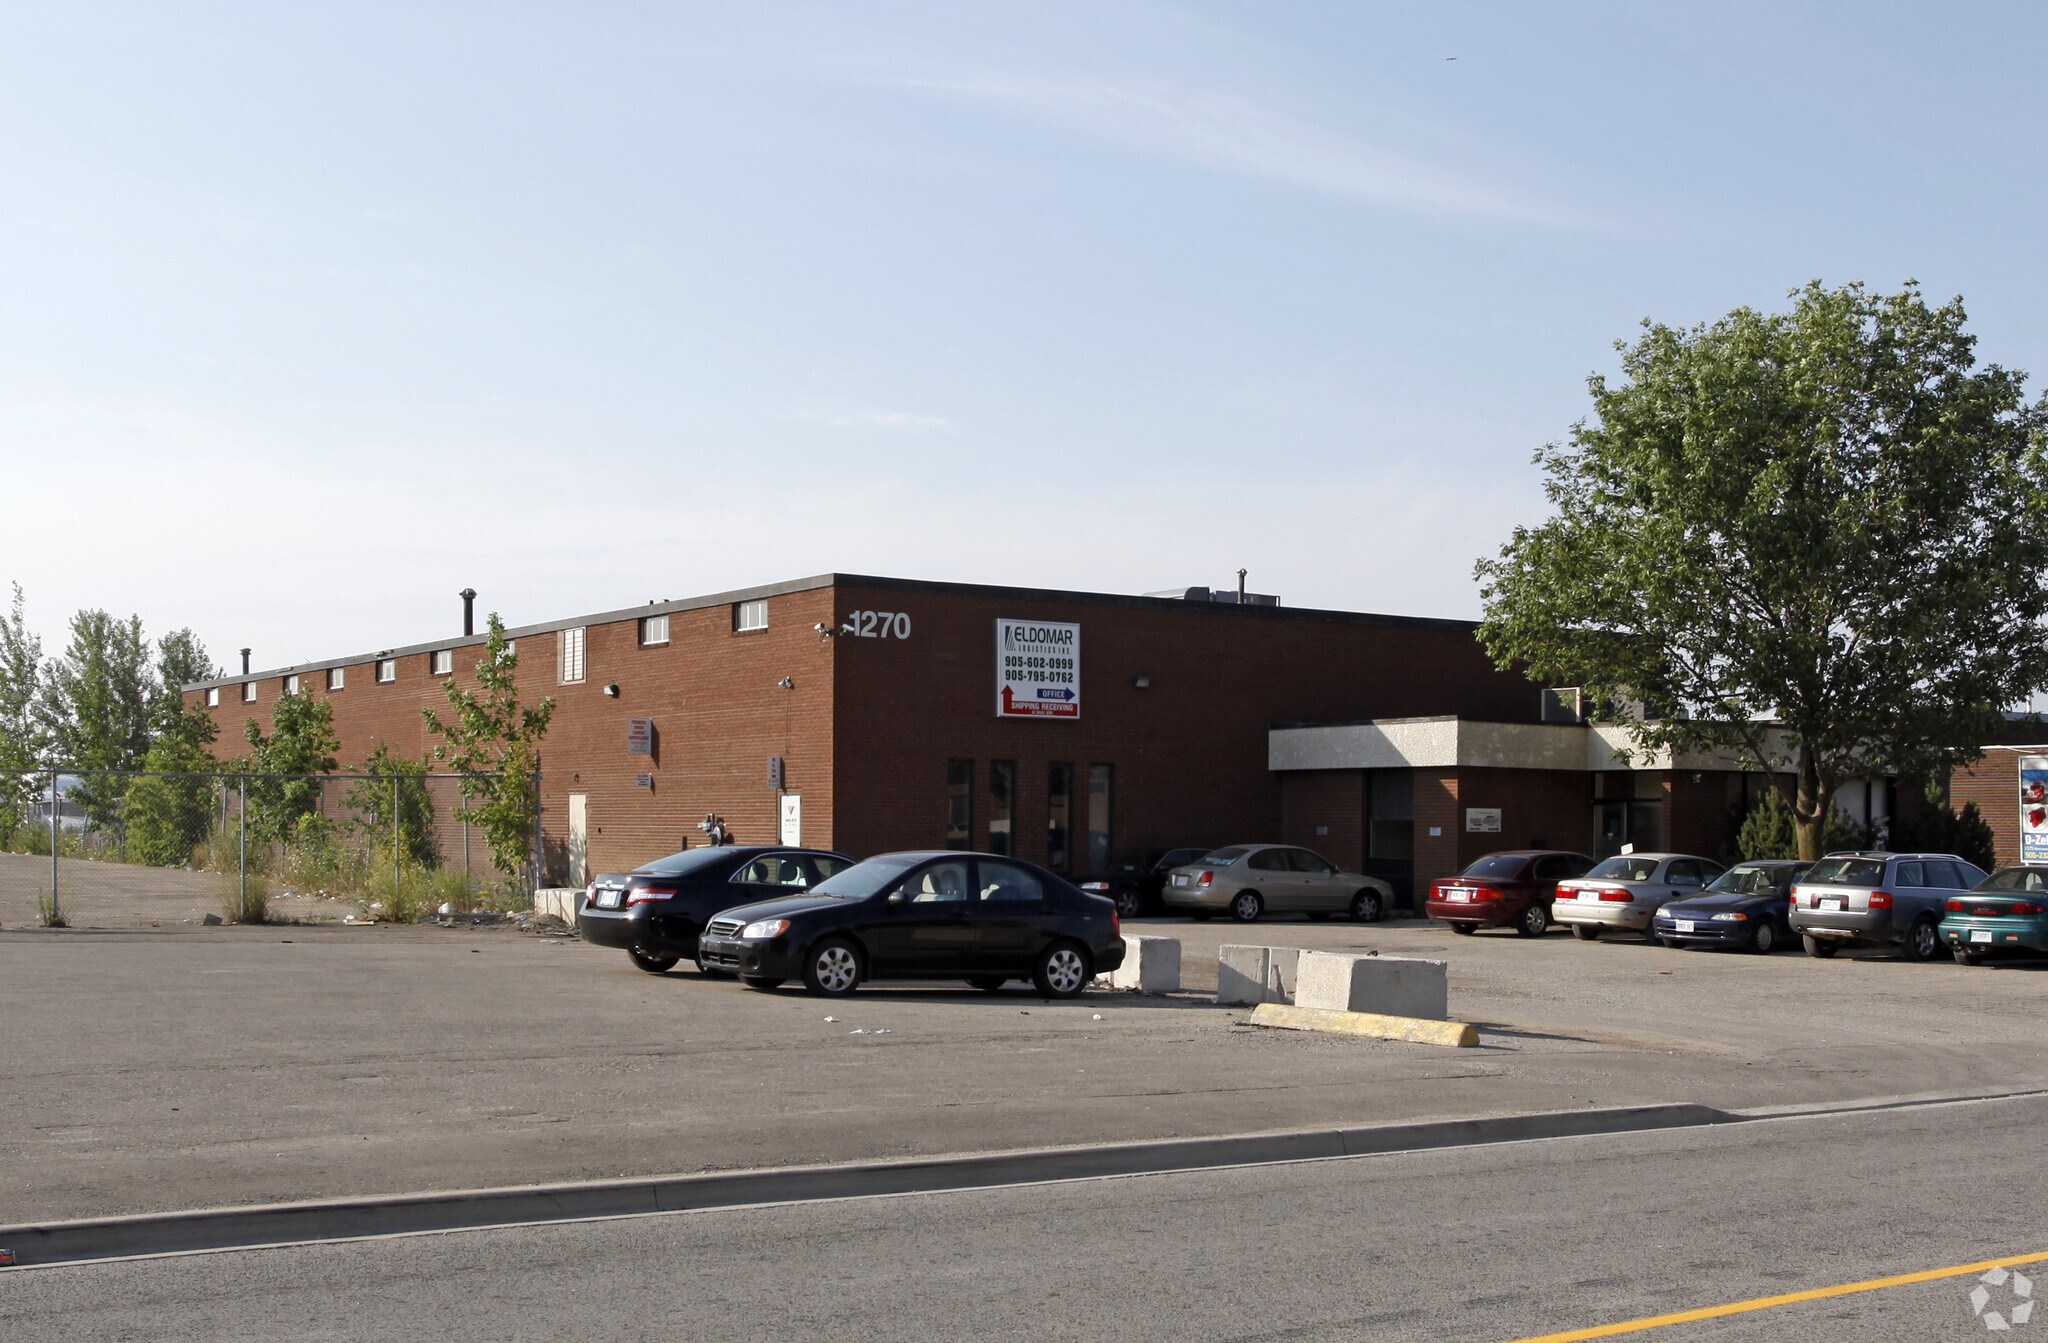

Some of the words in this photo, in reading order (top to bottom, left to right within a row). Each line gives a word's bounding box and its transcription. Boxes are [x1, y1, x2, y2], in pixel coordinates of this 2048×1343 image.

[849, 610, 911, 640] 1270
[1019, 645, 1056, 654] LOGISTICS
[1005, 656, 1073, 669] 905-602-0999
[1005, 670, 1073, 683] 905-795-0762
[1042, 690, 1065, 698] OFFICE
[1011, 702, 1040, 710] SHIPPING
[1041, 703, 1073, 711] RECEIVING
